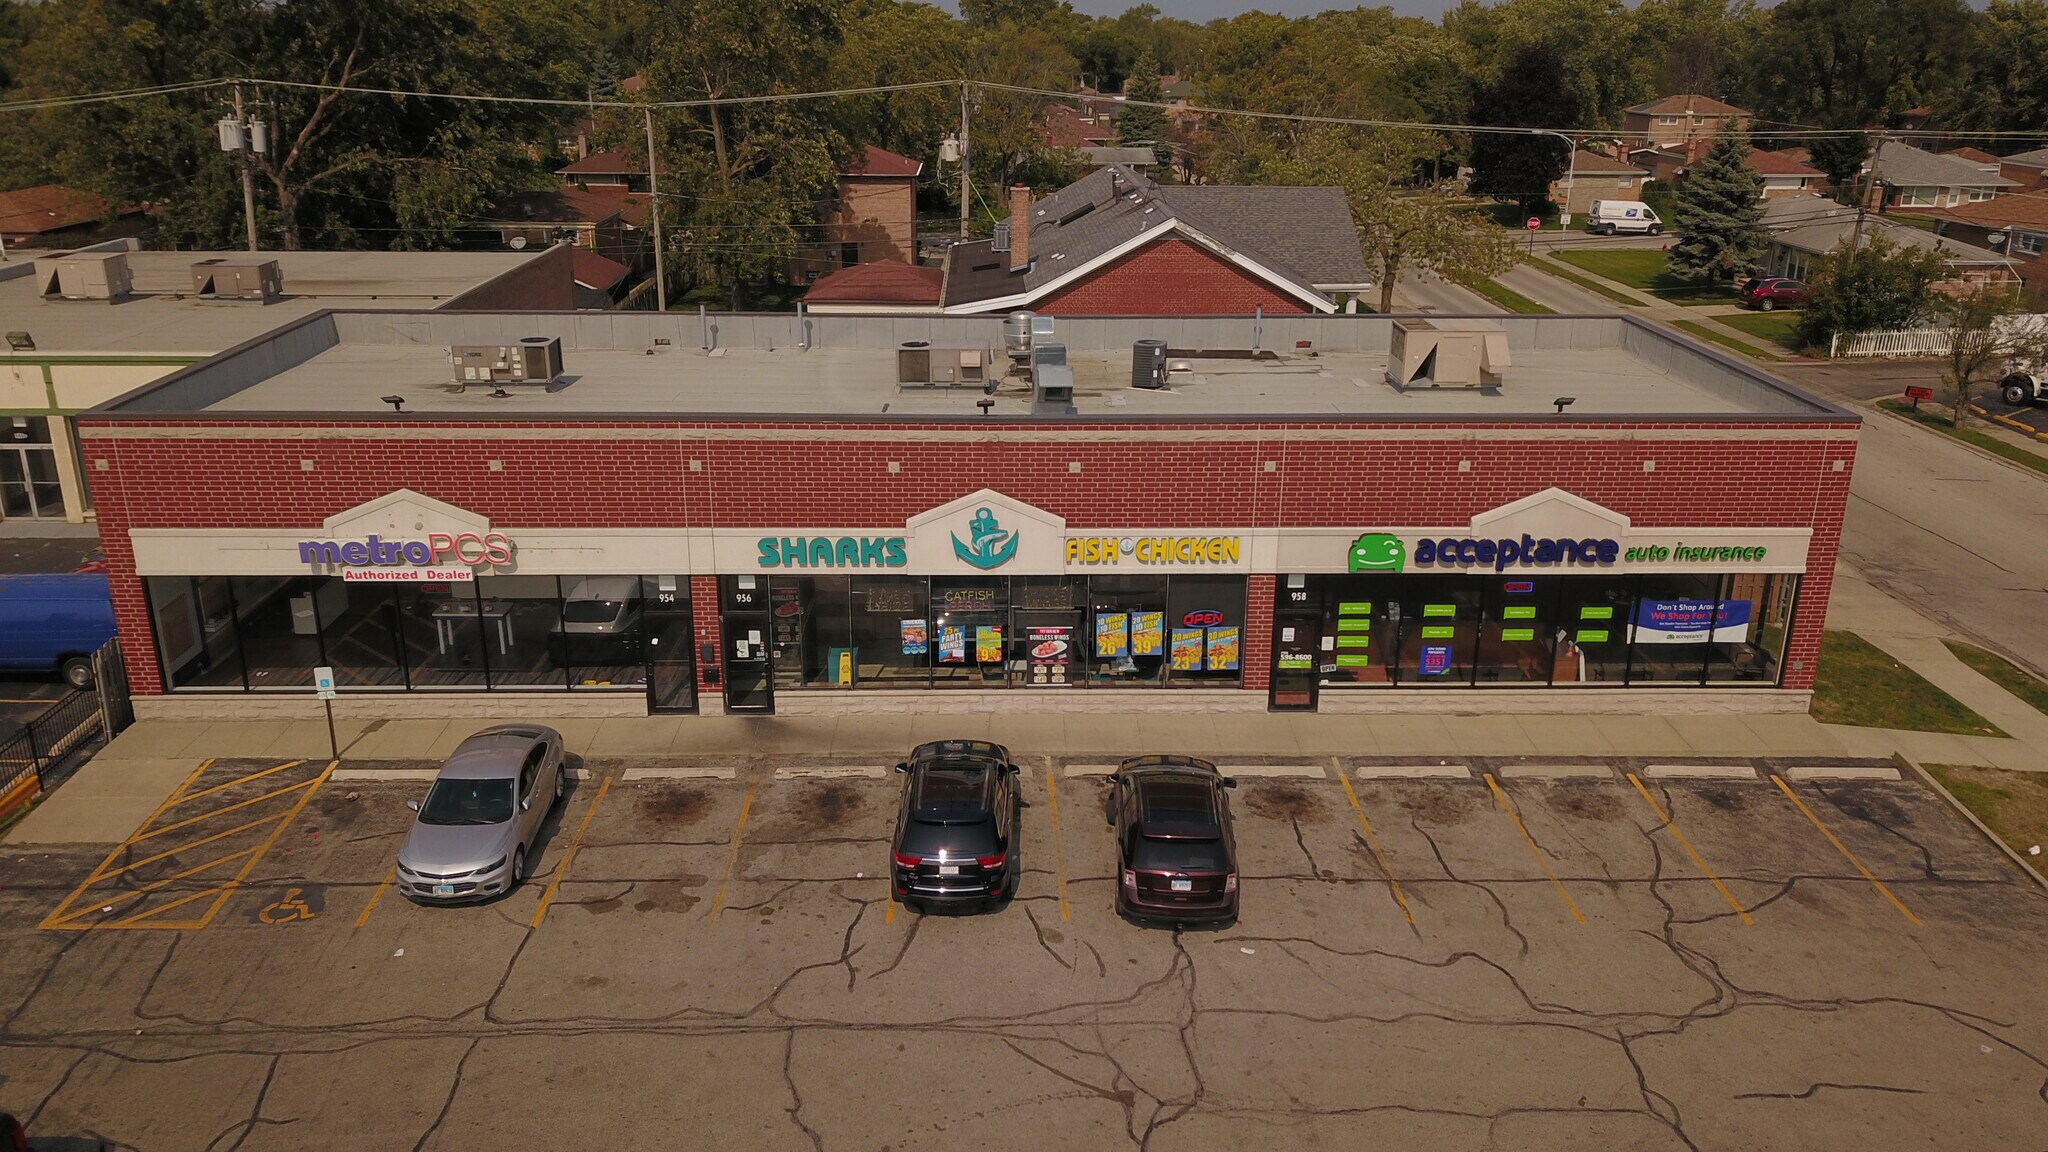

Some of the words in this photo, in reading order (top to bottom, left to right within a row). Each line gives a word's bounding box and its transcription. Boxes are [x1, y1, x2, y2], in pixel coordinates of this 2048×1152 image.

[298, 533, 510, 565] metroPCS
[757, 537, 907, 566] SHARKS
[1066, 537, 1119, 563] FISH
[1135, 536, 1240, 562] CHICKEN
[1414, 533, 1620, 571] acceptance
[1625, 546, 1670, 561] auto
[1673, 541, 1767, 560] insurance
[345, 570, 418, 580] Authorized
[427, 570, 471, 580] Dealer
[659, 594, 674, 602] 954
[736, 593, 751, 602] 956
[944, 590, 994, 602] CATFISH
[1291, 592, 1307, 601] 958
[1105, 614, 1127, 624] WINGS
[1141, 613, 1162, 622] WINGS
[1183, 613, 1224, 625] OPEN
[1668, 612, 1690, 621] Shop
[1109, 622, 1123, 630] FISH
[941, 632, 963, 643] PARTY
[940, 640, 964, 650] WINGS
